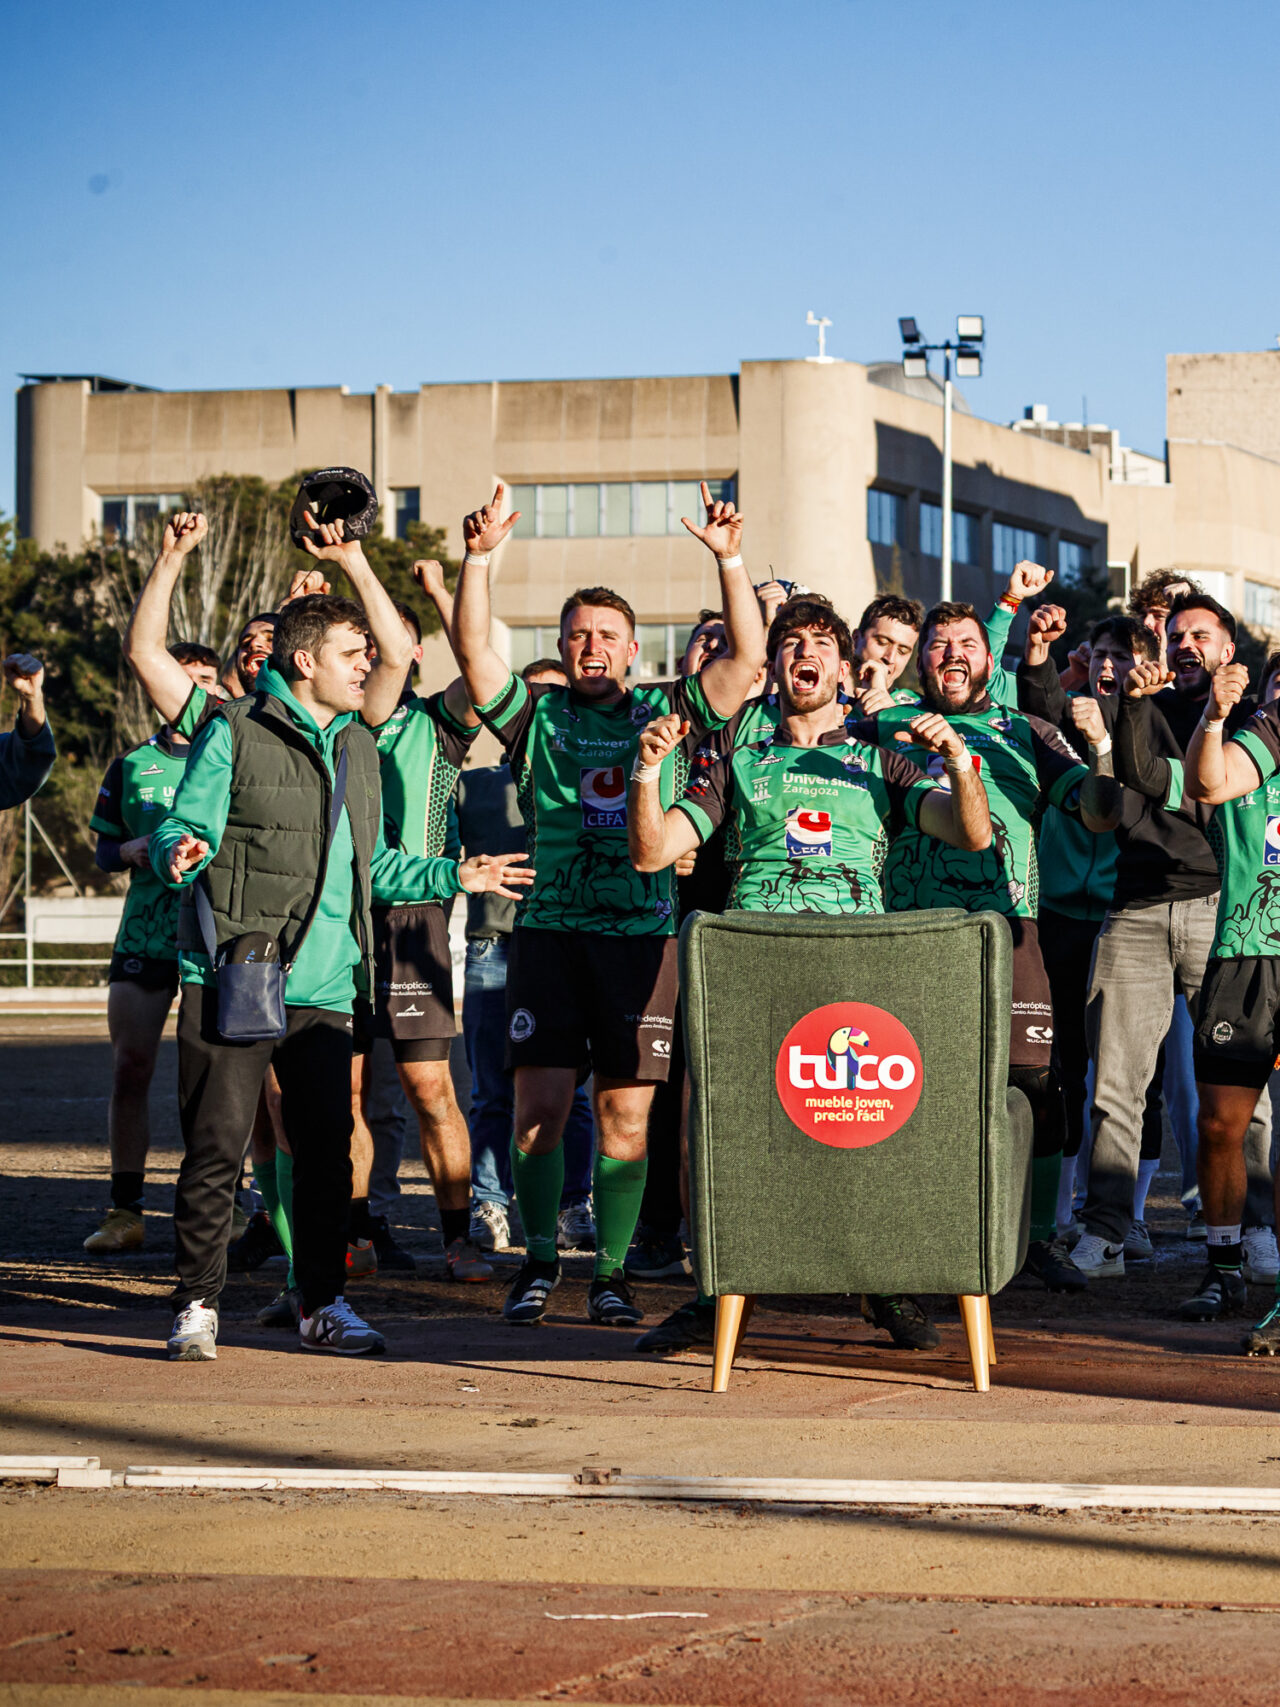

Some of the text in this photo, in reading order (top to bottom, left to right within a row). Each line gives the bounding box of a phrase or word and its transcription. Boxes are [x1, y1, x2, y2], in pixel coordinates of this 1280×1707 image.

[782, 772, 868, 792] Universidad
[783, 784, 839, 798] Zaragoza
[588, 813, 625, 827] CEFA
[789, 1045, 916, 1090] tuco
[805, 1096, 894, 1111] mueble joven,
[814, 1109, 885, 1123] precio fácil
